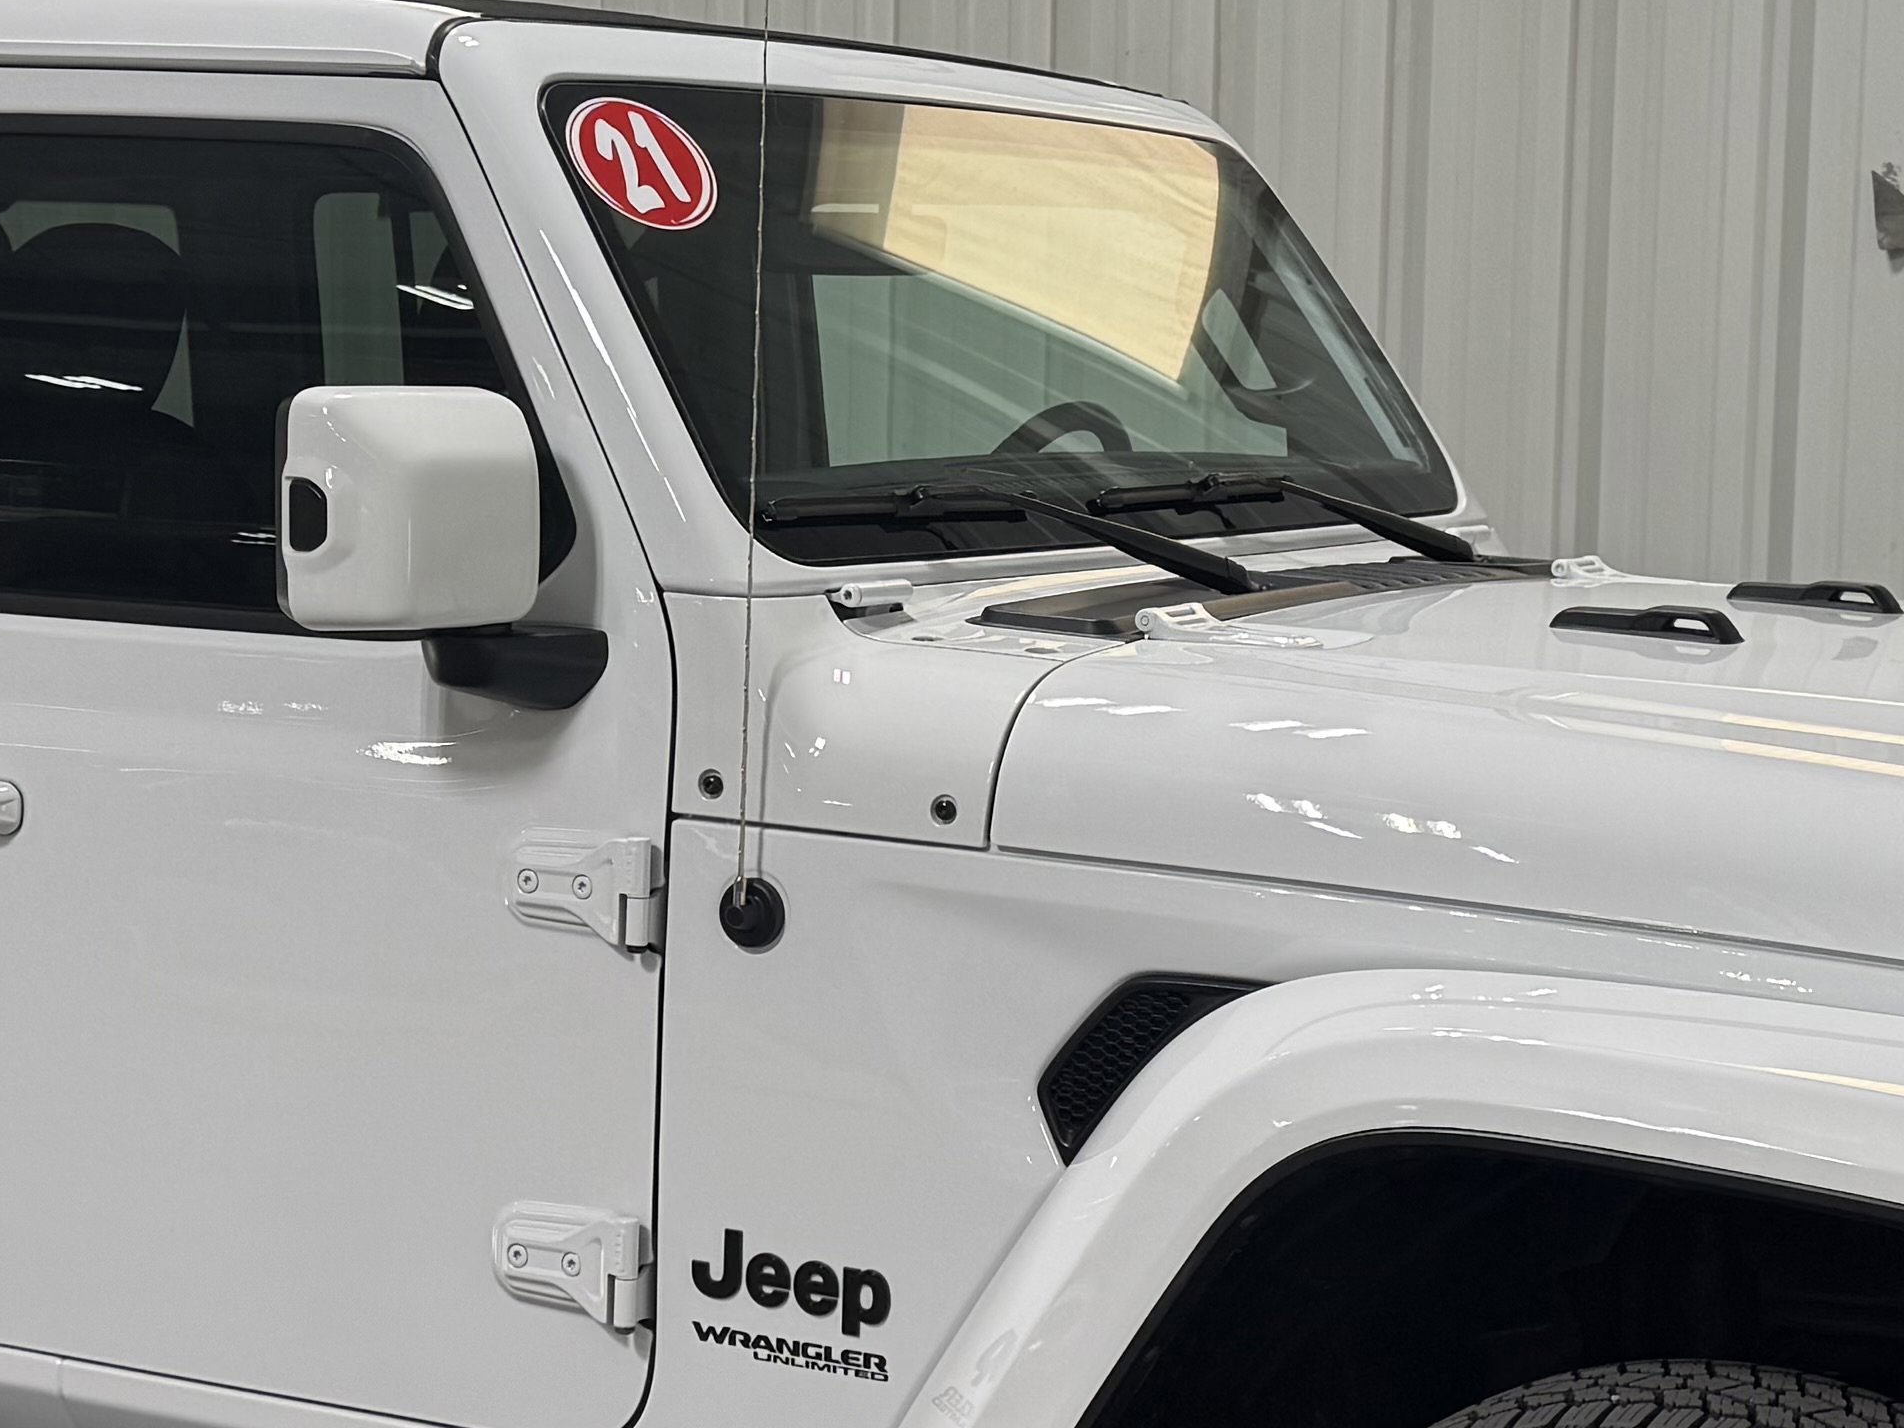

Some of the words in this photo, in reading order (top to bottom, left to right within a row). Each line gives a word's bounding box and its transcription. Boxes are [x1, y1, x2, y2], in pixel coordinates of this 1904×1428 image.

[594, 110, 692, 215] 21
[691, 1227, 892, 1338] Jeep
[691, 1320, 888, 1374] WRANGLER
[752, 1350, 889, 1382] UNLIMITED
